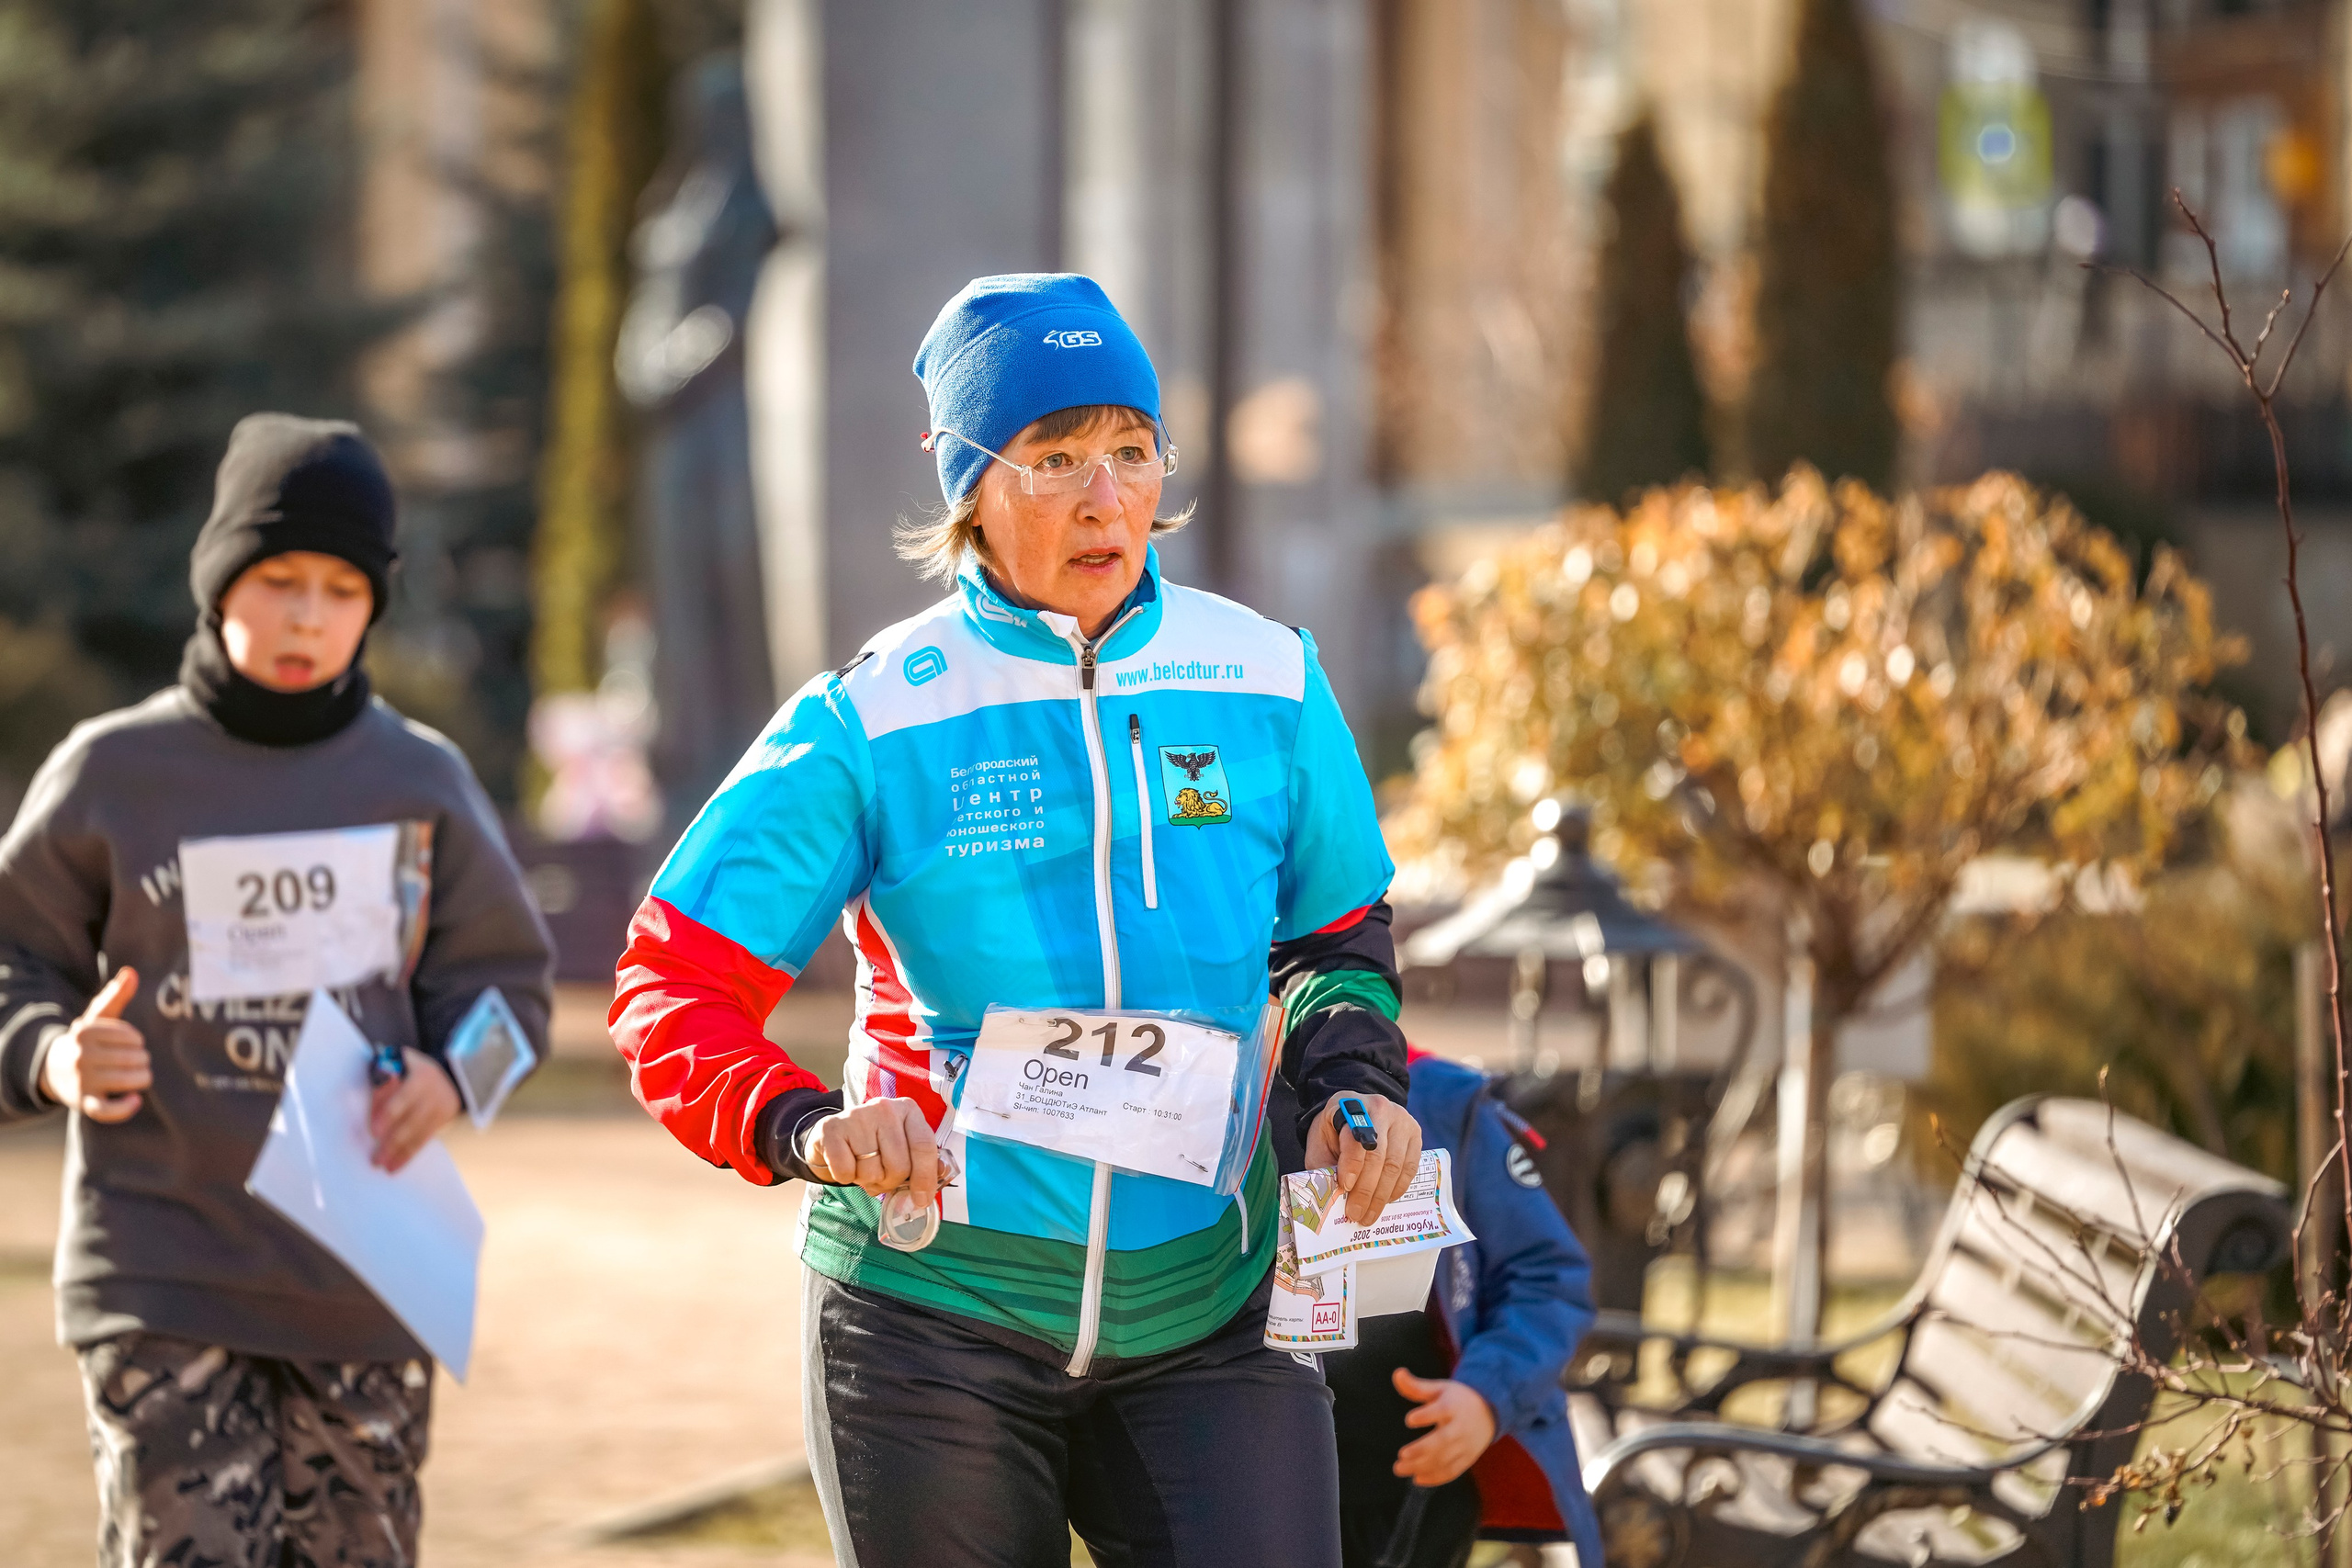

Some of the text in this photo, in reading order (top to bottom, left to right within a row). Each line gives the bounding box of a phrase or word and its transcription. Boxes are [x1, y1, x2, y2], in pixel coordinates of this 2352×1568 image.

[1058, 330, 1102, 348] GS
[1115, 660, 1244, 687] www.belcdtur.ru
[951, 769, 1041, 793] областной
[952, 806, 1044, 826] етского и
[944, 836, 1046, 858] туризма
[236, 863, 336, 919] 209
[1043, 1017, 1167, 1077] 212
[1023, 1058, 1089, 1090] Open
[1018, 1080, 1064, 1098] Чан Галина
[1042, 1107, 1075, 1121] 1007633
[1079, 1104, 1108, 1117] Атлант
[1122, 1102, 1147, 1114] Старт
[1153, 1109, 1182, 1121] 10:31:00
